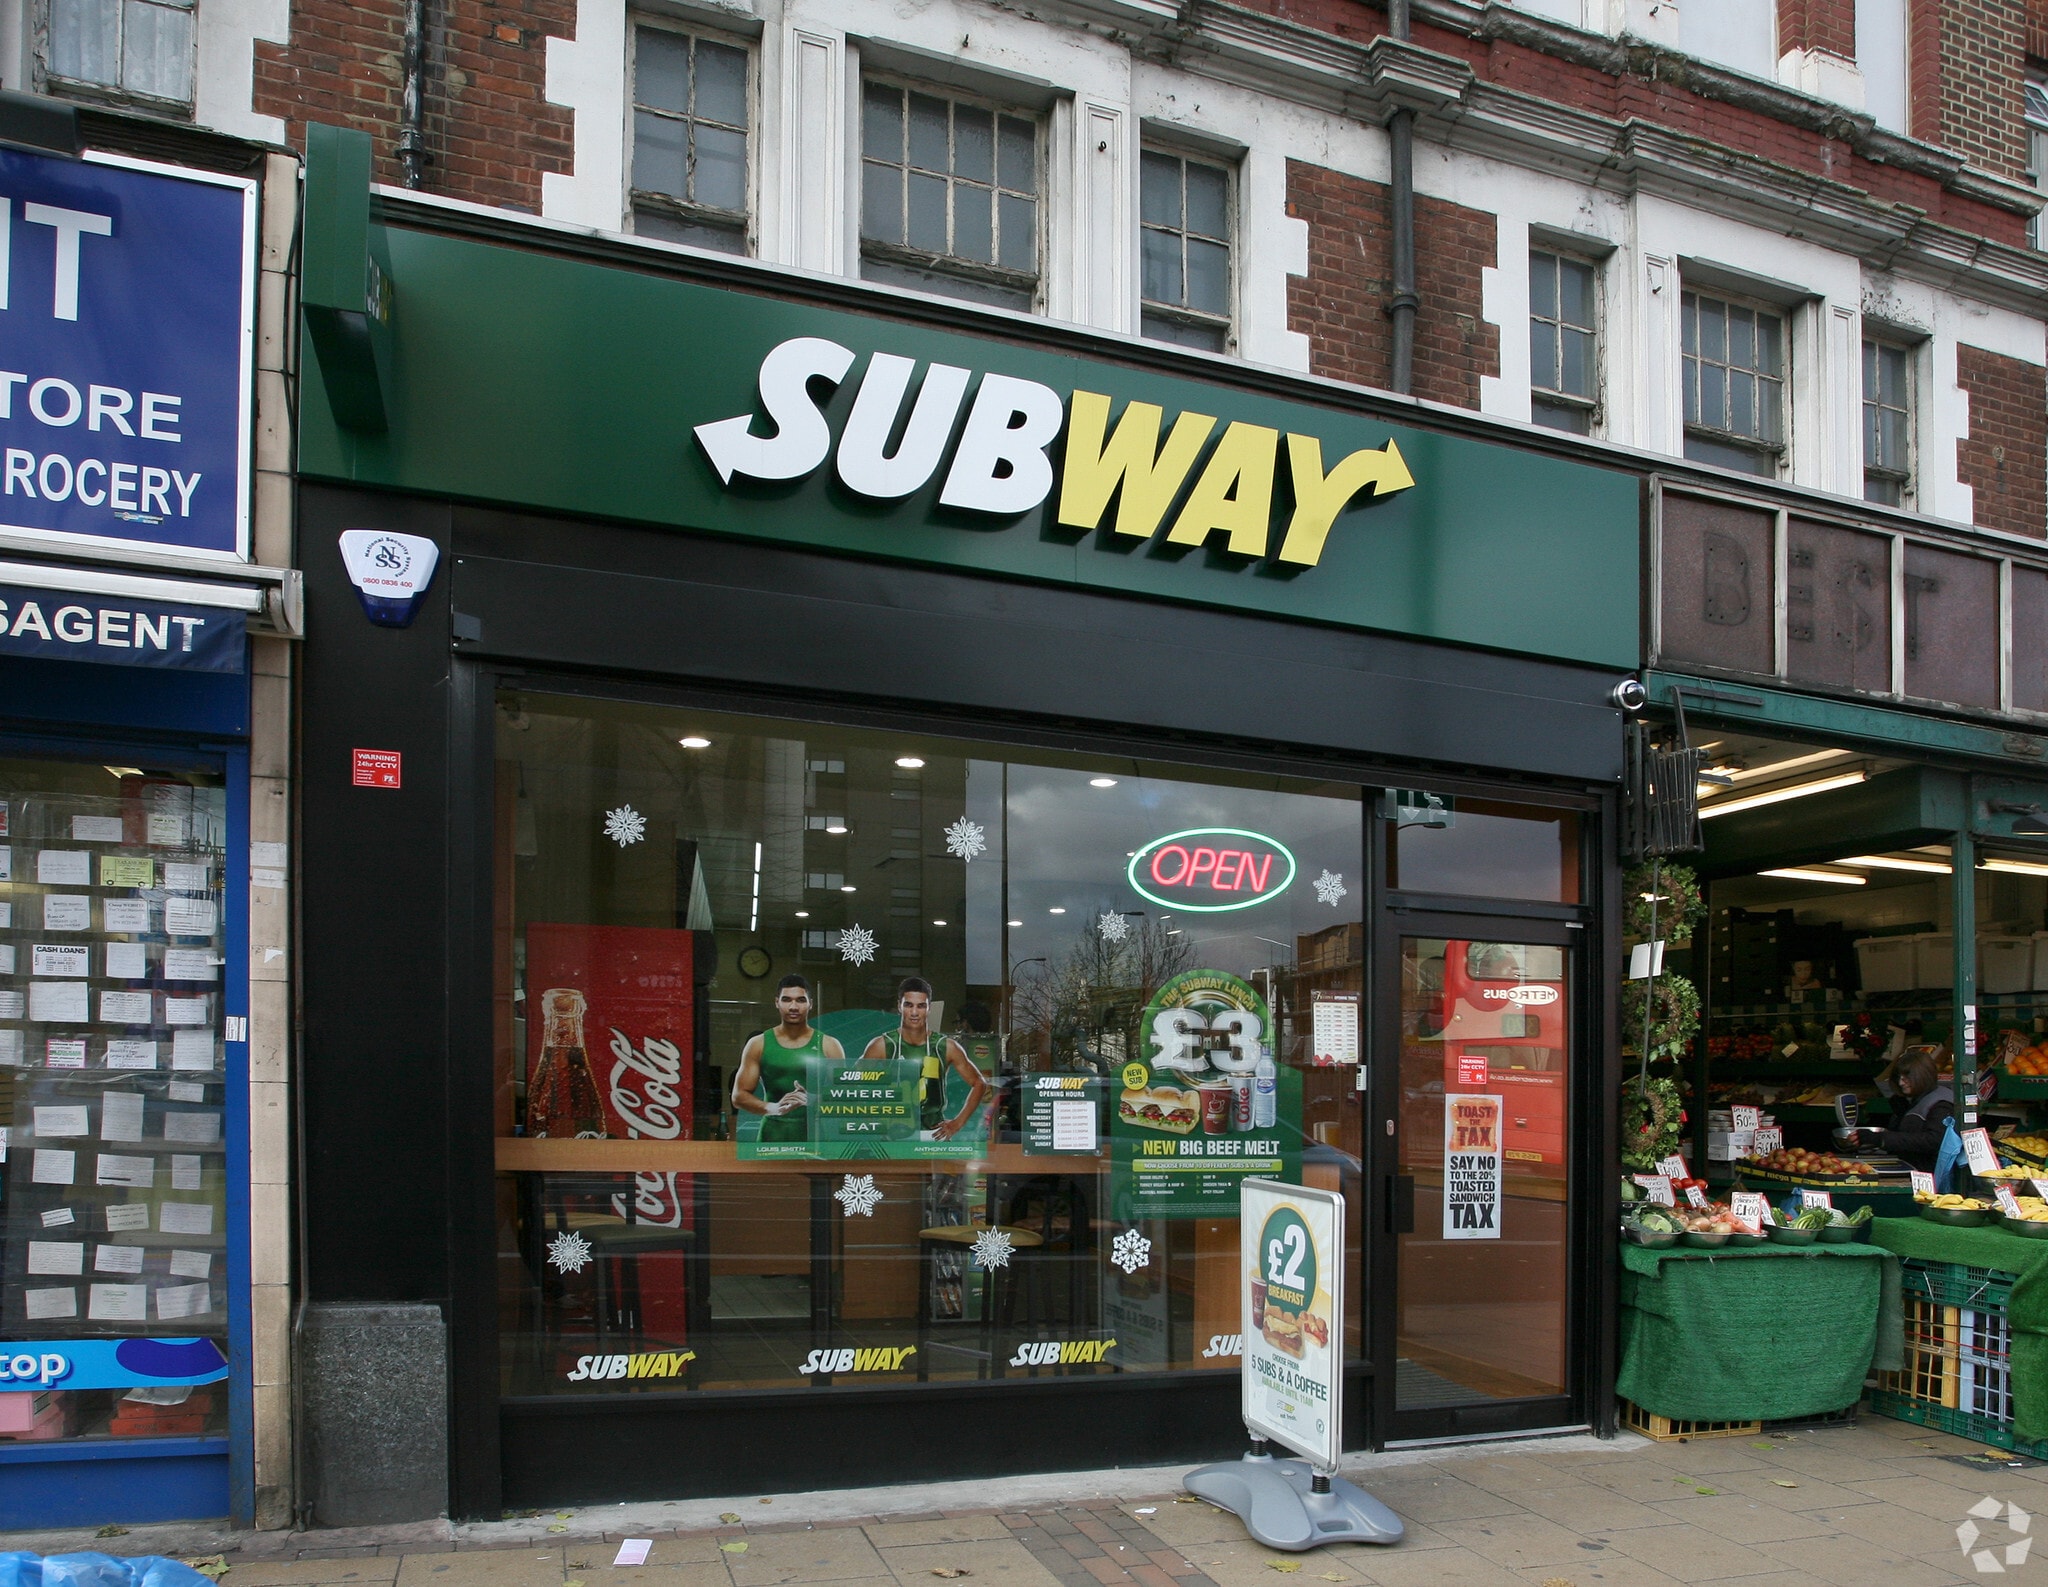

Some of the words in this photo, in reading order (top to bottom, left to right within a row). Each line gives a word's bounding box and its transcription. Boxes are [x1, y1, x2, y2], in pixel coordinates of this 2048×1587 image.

[693, 336, 1416, 567] SUBWAY
[357, 753, 396, 762] WARNING
[1151, 844, 1274, 893] OPEN
[59, 947, 86, 955] LOANS
[1161, 988, 1180, 1008] THE
[1180, 977, 1224, 994] SUBWAY
[1224, 982, 1258, 1011] LUNCH
[1150, 1008, 1264, 1072] £3
[840, 1070, 884, 1081] SUBWAY
[1127, 1068, 1142, 1077] NEW
[1034, 1077, 1089, 1090] SUBWAY
[1129, 1076, 1143, 1085] SUB
[830, 1089, 895, 1098] WHERE
[1038, 1090, 1064, 1098] OPENING
[820, 1105, 906, 1115] WINNERS
[1236, 1087, 1250, 1124] Coke
[1457, 1105, 1492, 1119] TOAST
[846, 1122, 881, 1131] EAT
[1469, 1118, 1480, 1126] THE
[1456, 1126, 1492, 1147] TAX
[1143, 1141, 1176, 1156] NEW
[1179, 1141, 1202, 1156] BIG
[1206, 1141, 1242, 1156] BEEF
[1244, 1141, 1281, 1157] MELT
[1450, 1156, 1475, 1170] SAY
[1477, 1156, 1495, 1170] NO
[1450, 1171, 1460, 1180] TO
[1462, 1171, 1477, 1180] THE
[1478, 1171, 1496, 1180] 20%
[1767, 1172, 1790, 1181] mega
[1449, 1181, 1495, 1192] TOASTED
[1449, 1192, 1495, 1203] SANDWICH
[1449, 1203, 1494, 1229] TAX
[1267, 1224, 1306, 1292] £2
[1267, 1284, 1305, 1308] BREAKFAST
[1009, 1337, 1118, 1368] SUBWAY
[567, 1350, 697, 1382] SUBWAY
[798, 1344, 918, 1376] SUBWAY
[1272, 1353, 1287, 1367] CHOOSE
[1251, 1354, 1257, 1369] 5
[1257, 1356, 1277, 1379] SUBS
[1278, 1367, 1285, 1382] &
[1286, 1371, 1293, 1387] A
[1294, 1374, 1328, 1401] COFFEE
